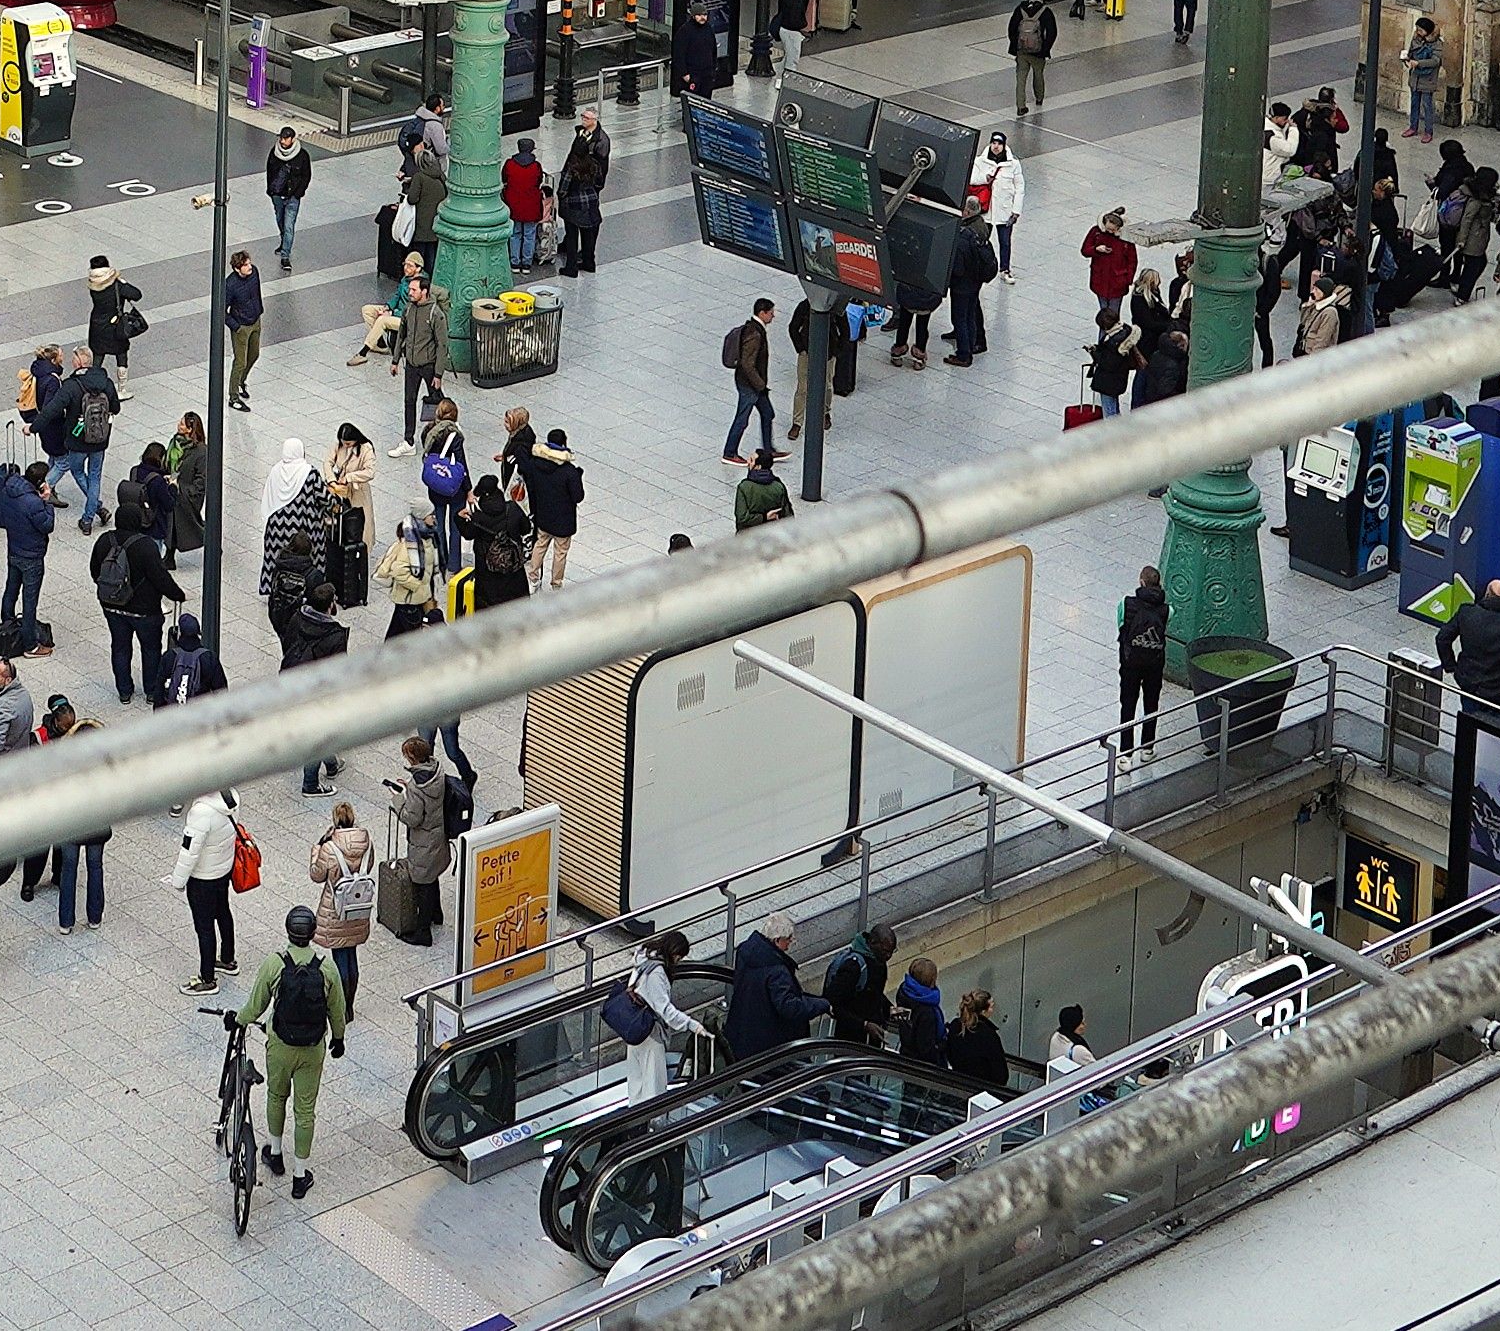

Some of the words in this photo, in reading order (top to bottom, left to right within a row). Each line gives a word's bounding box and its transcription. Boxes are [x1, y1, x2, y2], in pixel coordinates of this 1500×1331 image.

[482, 850, 520, 871] Petite
[1371, 855, 1390, 873] WC
[480, 869, 504, 889] soif
[507, 866, 512, 880] !
